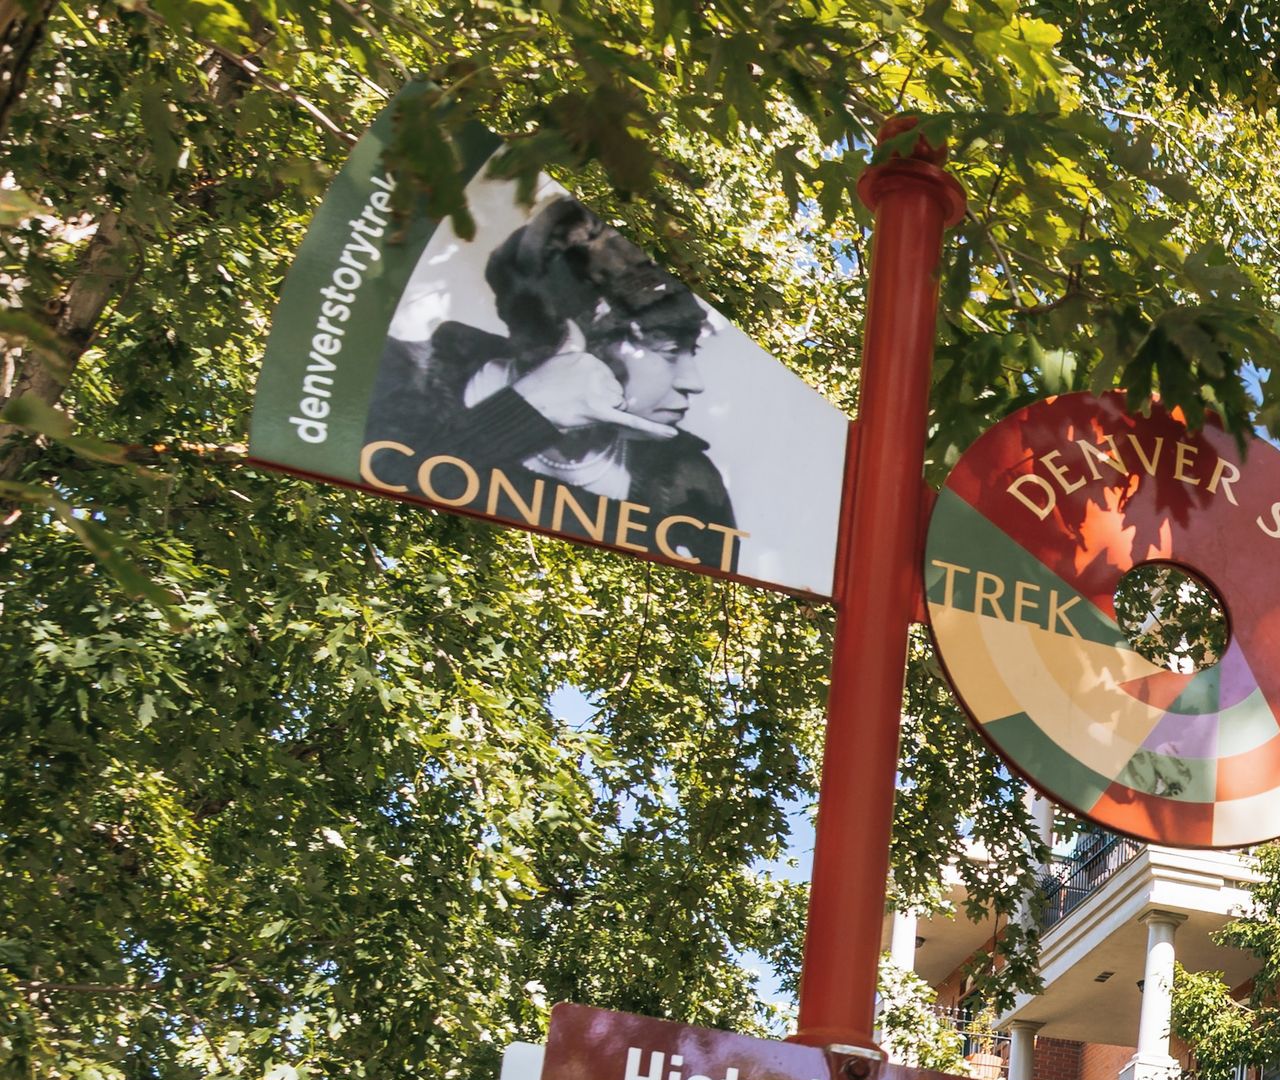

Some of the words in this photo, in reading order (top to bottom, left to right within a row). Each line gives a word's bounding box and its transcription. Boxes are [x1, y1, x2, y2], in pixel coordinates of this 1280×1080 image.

[359, 440, 751, 573] CONNECT
[1006, 432, 1242, 521] DENVER
[931, 559, 1082, 639] TREK
